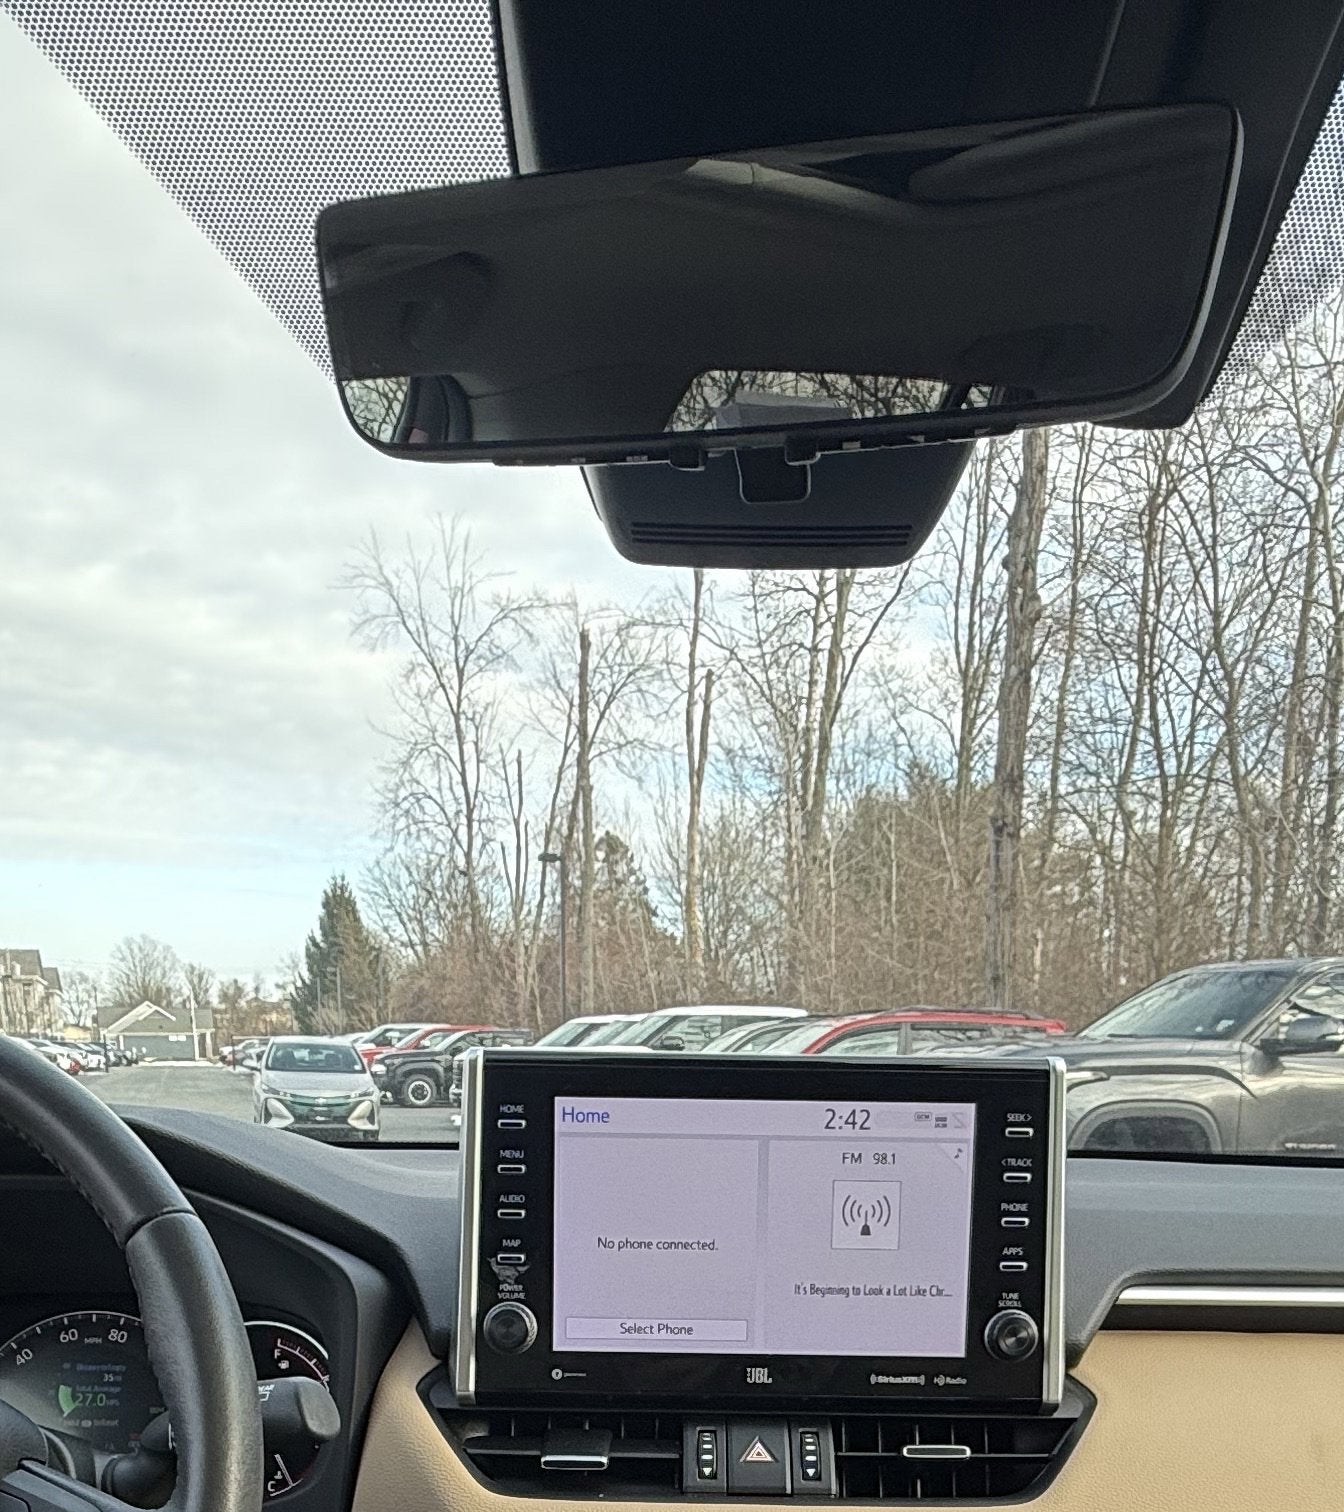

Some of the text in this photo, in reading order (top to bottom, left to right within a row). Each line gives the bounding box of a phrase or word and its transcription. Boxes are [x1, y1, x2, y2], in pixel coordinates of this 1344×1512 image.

[499, 1104, 525, 1114] HOME
[561, 1106, 610, 1123] Home
[823, 1108, 871, 1130] 2:42
[499, 1149, 524, 1159] MENU
[842, 1152, 896, 1165] FM 98.1
[499, 1194, 525, 1203] AUDIO
[1000, 1203, 1029, 1212] PHONE
[502, 1239, 521, 1247] MAP
[597, 1237, 718, 1251] No phone connected.
[1002, 1246, 1024, 1256] APPS
[497, 1292, 526, 1300] VOLUME
[794, 1283, 807, 1295] It's
[809, 1284, 850, 1297] Beginning
[852, 1285, 861, 1296] to
[863, 1285, 884, 1296] Look
[893, 1285, 907, 1297] Lot
[909, 1285, 928, 1297] Like
[1001, 1292, 1020, 1300] TUNE
[619, 1322, 694, 1335] Select Phone
[59, 1329, 78, 1343] 60
[108, 1328, 128, 1343] 80
[15, 1348, 33, 1366] 40
[274, 1348, 281, 1359] F
[103, 1374, 114, 1383] 35
[746, 1367, 773, 1384] JBL
[75, 1393, 107, 1407] 27.0
[267, 1480, 276, 1492] C
